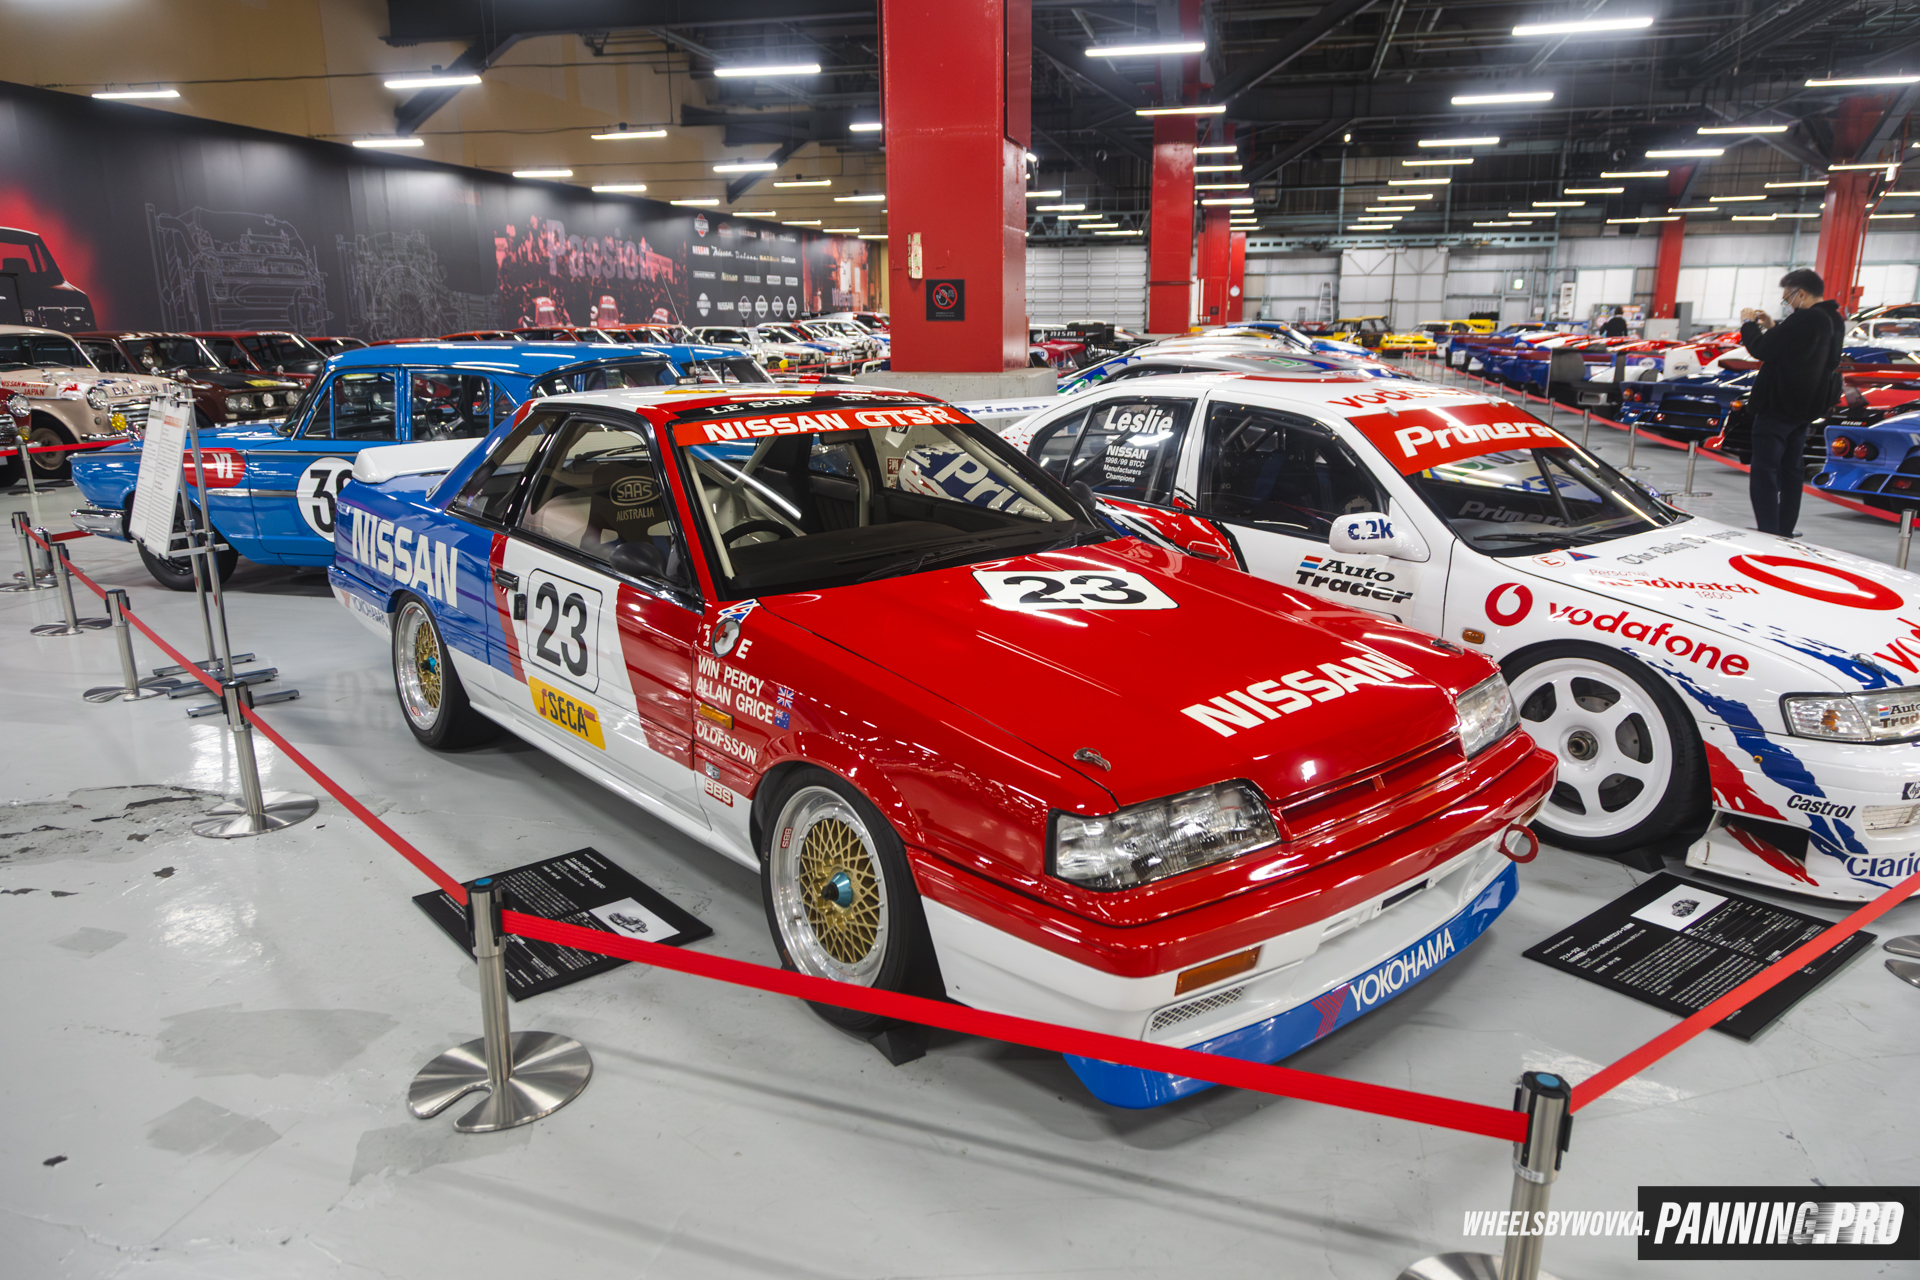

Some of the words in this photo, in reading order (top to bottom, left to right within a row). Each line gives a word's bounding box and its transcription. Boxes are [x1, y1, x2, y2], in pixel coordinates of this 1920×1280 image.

[546, 219, 653, 281] Passion
[705, 405, 744, 414] LE
[1104, 404, 1173, 434] Leslie
[702, 413, 849, 441] NISSAN
[1395, 421, 1554, 458] Primera
[1106, 445, 1149, 460] NISSAN
[1103, 464, 1142, 476] Manufacturers
[1105, 472, 1135, 483] Champions
[616, 507, 655, 522] AUSTRALIA
[352, 507, 458, 608] NISSAN
[1318, 560, 1395, 582] Auto
[1004, 574, 1147, 605] 23
[1296, 570, 1413, 604] Trader
[1695, 590, 1733, 600] 1800
[535, 582, 588, 676] 23
[1548, 602, 1750, 676] vodafone
[698, 655, 719, 680] WIN
[723, 665, 764, 698] PERCY
[696, 676, 731, 706] ALLAN
[735, 693, 774, 725] GRICE
[1180, 653, 1414, 738] NISSAN
[704, 778, 733, 806] BBS
[1787, 795, 1856, 819] Castrol
[782, 828, 792, 848] BBS
[1349, 927, 1456, 1012] YOKOHAMA
